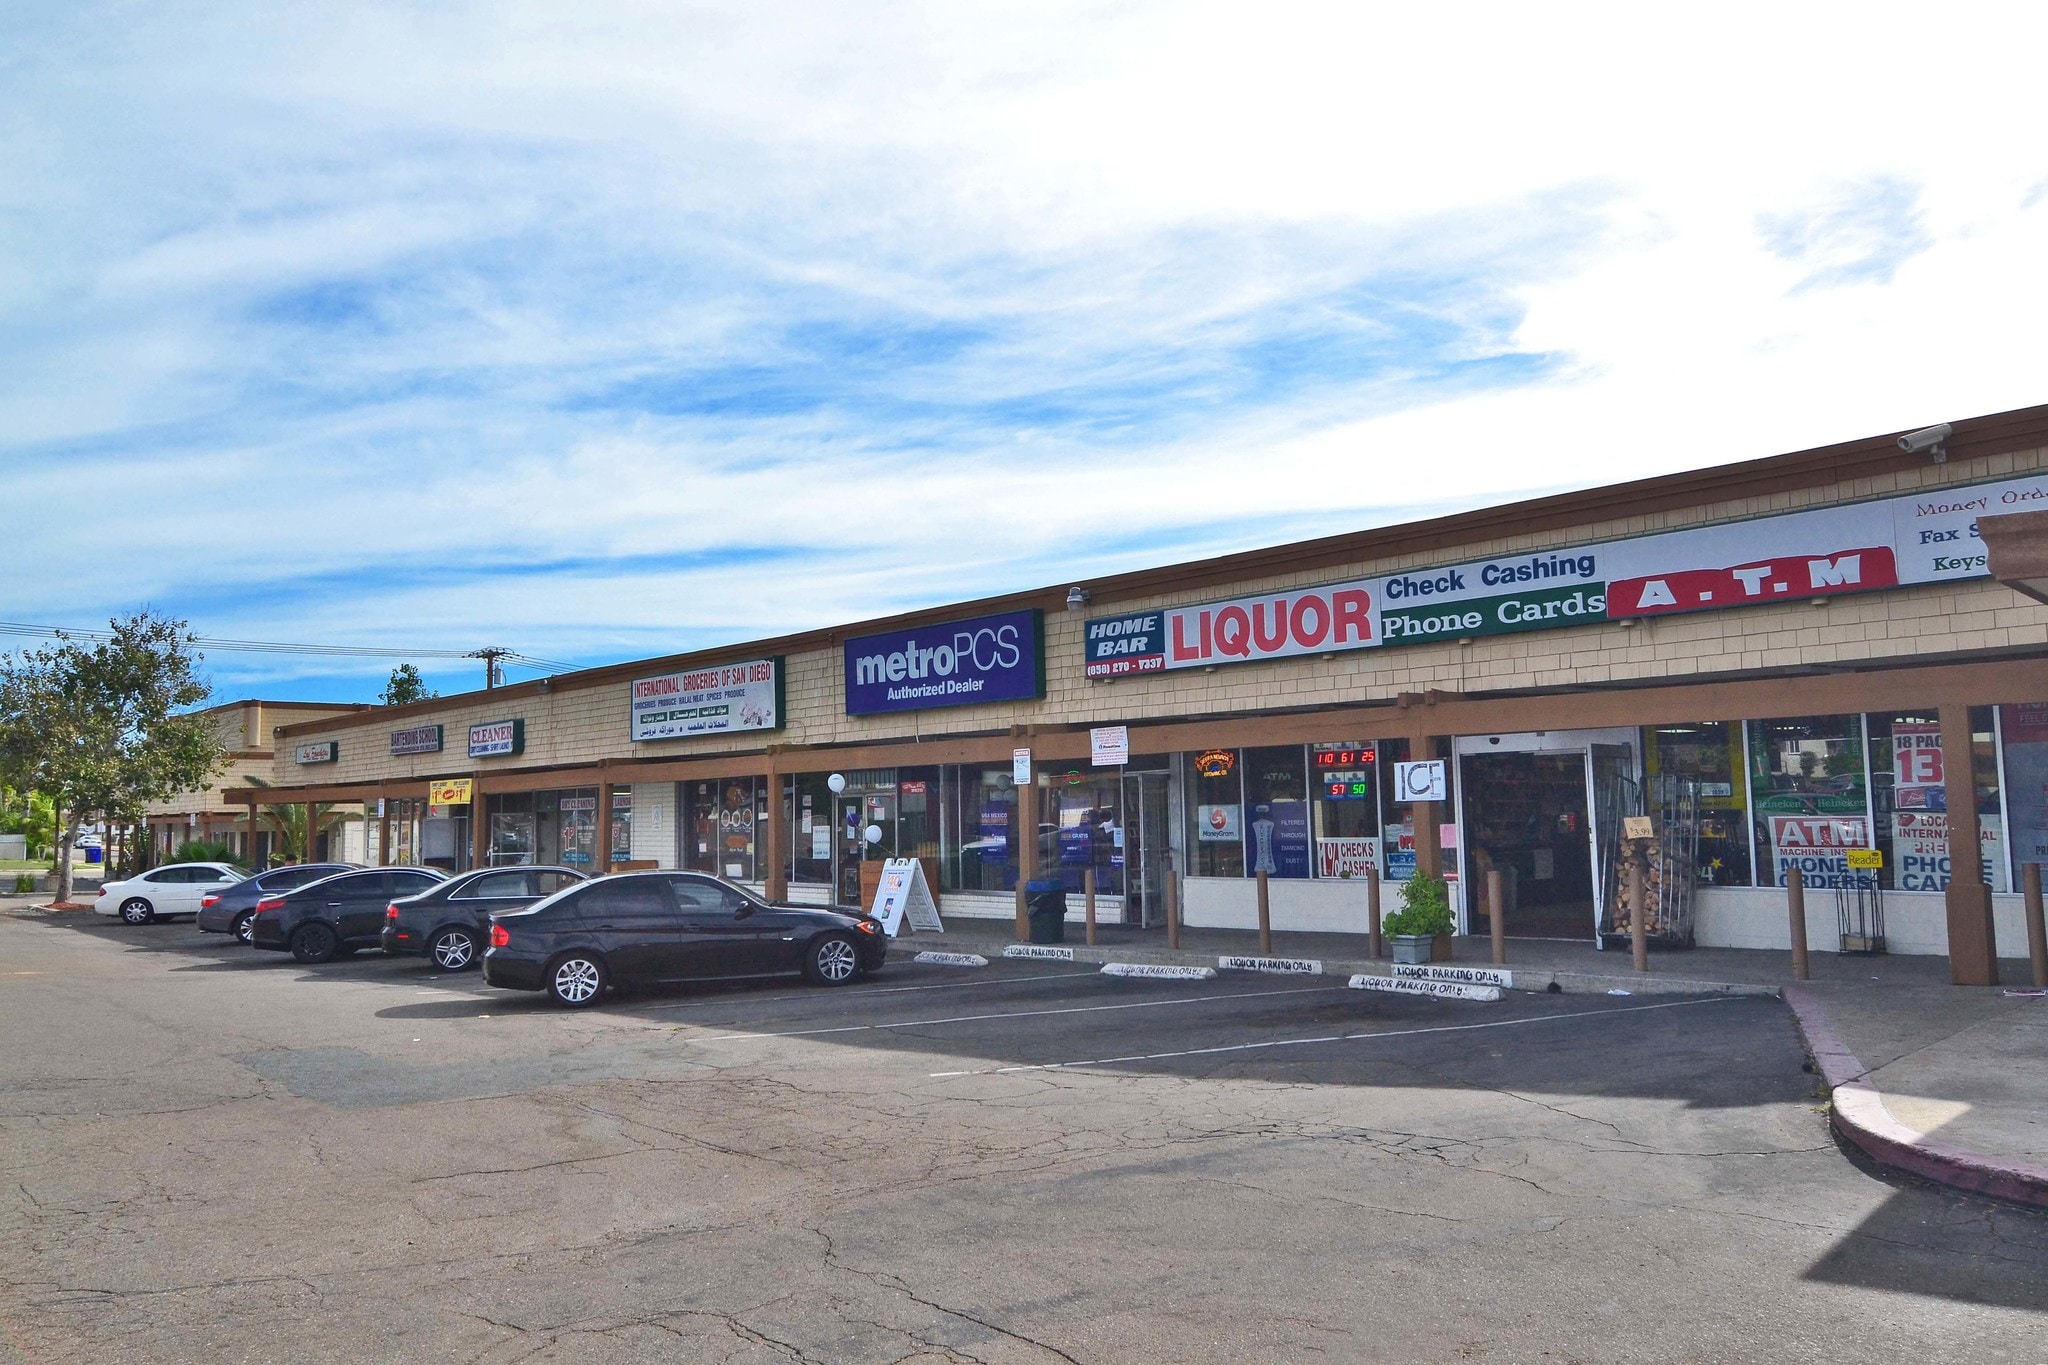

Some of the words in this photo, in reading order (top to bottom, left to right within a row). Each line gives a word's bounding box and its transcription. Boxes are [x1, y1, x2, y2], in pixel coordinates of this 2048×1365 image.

[1916, 497, 1987, 517] Money
[2002, 487, 2048, 504] Ord
[1919, 529, 1960, 545] Fax
[1933, 554, 1986, 572] Keys
[1386, 570, 1465, 599] Check
[1481, 555, 1596, 586] Cashing
[1171, 589, 1372, 658] LIQUOR
[1382, 611, 1483, 639] Phone
[1497, 592, 1606, 624] Cards
[1089, 616, 1157, 640] HOME
[856, 624, 1020, 685] metroPCS
[1096, 636, 1148, 657] BAR
[634, 676, 680, 698] INTERNATIONAL
[683, 671, 719, 691] GROCERIES
[721, 669, 730, 687] OF
[732, 666, 746, 685] SAN
[749, 662, 771, 682] DIEGO
[887, 681, 945, 700] Authorized
[947, 678, 985, 694] Dealer
[634, 702, 656, 710] GROCERIES
[657, 698, 677, 707] PRODUCE
[679, 696, 692, 704] HALAL
[693, 694, 704, 702] MEAT
[706, 691, 722, 701] SPICES
[724, 688, 746, 699] PRODUCE
[1894, 736, 1912, 749] 18
[1916, 735, 1943, 748] PAC
[1318, 753, 1334, 764] 110
[1341, 752, 1354, 763] 61
[1361, 751, 1375, 762] 25
[1896, 748, 1944, 783] 13
[1332, 784, 1345, 795] 57
[1352, 783, 1366, 794] 50
[1400, 762, 1442, 800] ICE
[1756, 800, 1800, 808] Heineken
[1818, 798, 1867, 808] Heineken
[1400, 835, 1415, 849] OPE
[1780, 821, 1865, 846] ATM
[1899, 828, 1997, 841] INTERNAAL
[1341, 842, 1374, 857] CHECKS
[1780, 848, 1825, 856] MACHINE
[1848, 854, 1880, 865] Reader
[1780, 857, 1863, 873] MONE
[1903, 856, 1993, 876] PHOE
